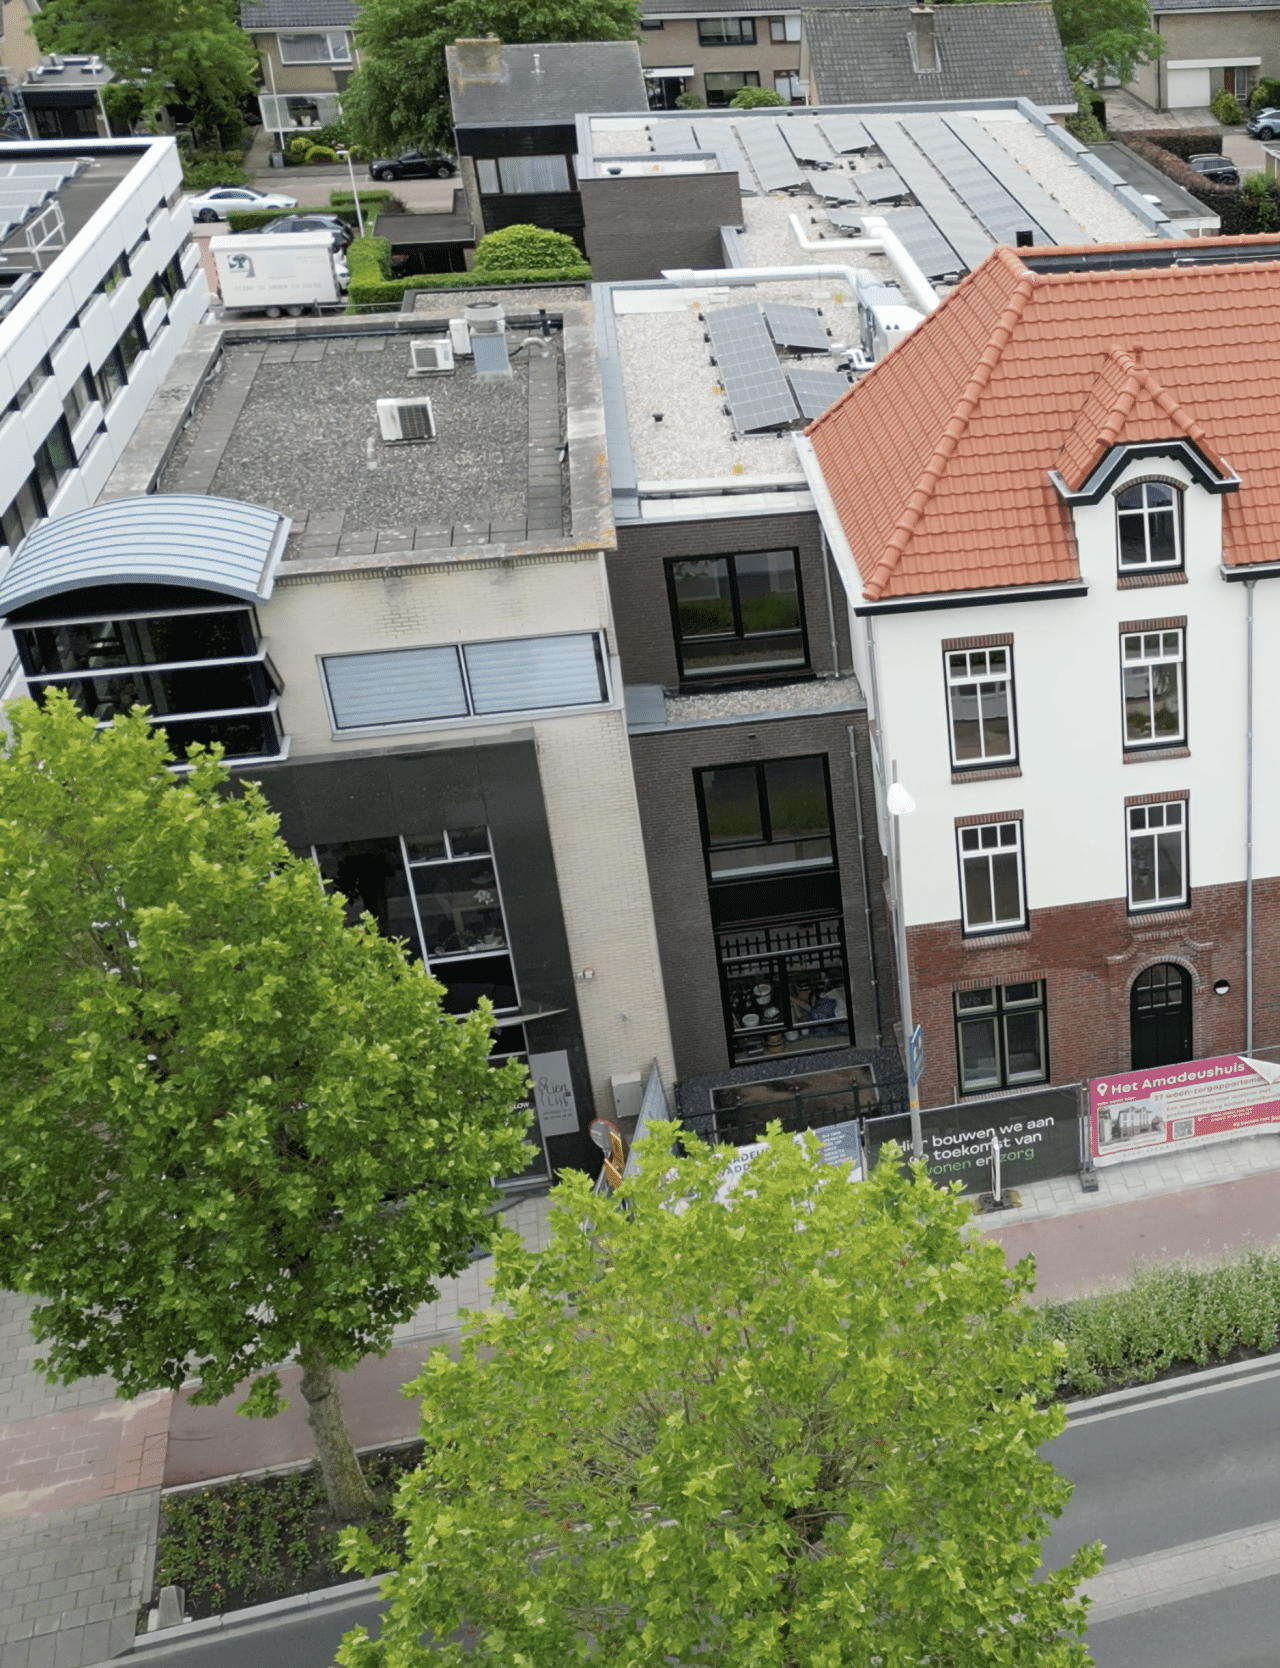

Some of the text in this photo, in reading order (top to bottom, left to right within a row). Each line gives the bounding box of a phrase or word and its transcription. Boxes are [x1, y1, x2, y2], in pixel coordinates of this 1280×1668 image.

[1111, 1062, 1245, 1096] Het Amadeushuis
[898, 1116, 1055, 1152] Hir bouwen we aan
[933, 1137, 1011, 1160] toekomst
[1014, 1132, 1042, 1146] van
[927, 1160, 971, 1175] onen
[1000, 1148, 1035, 1163] zorg
